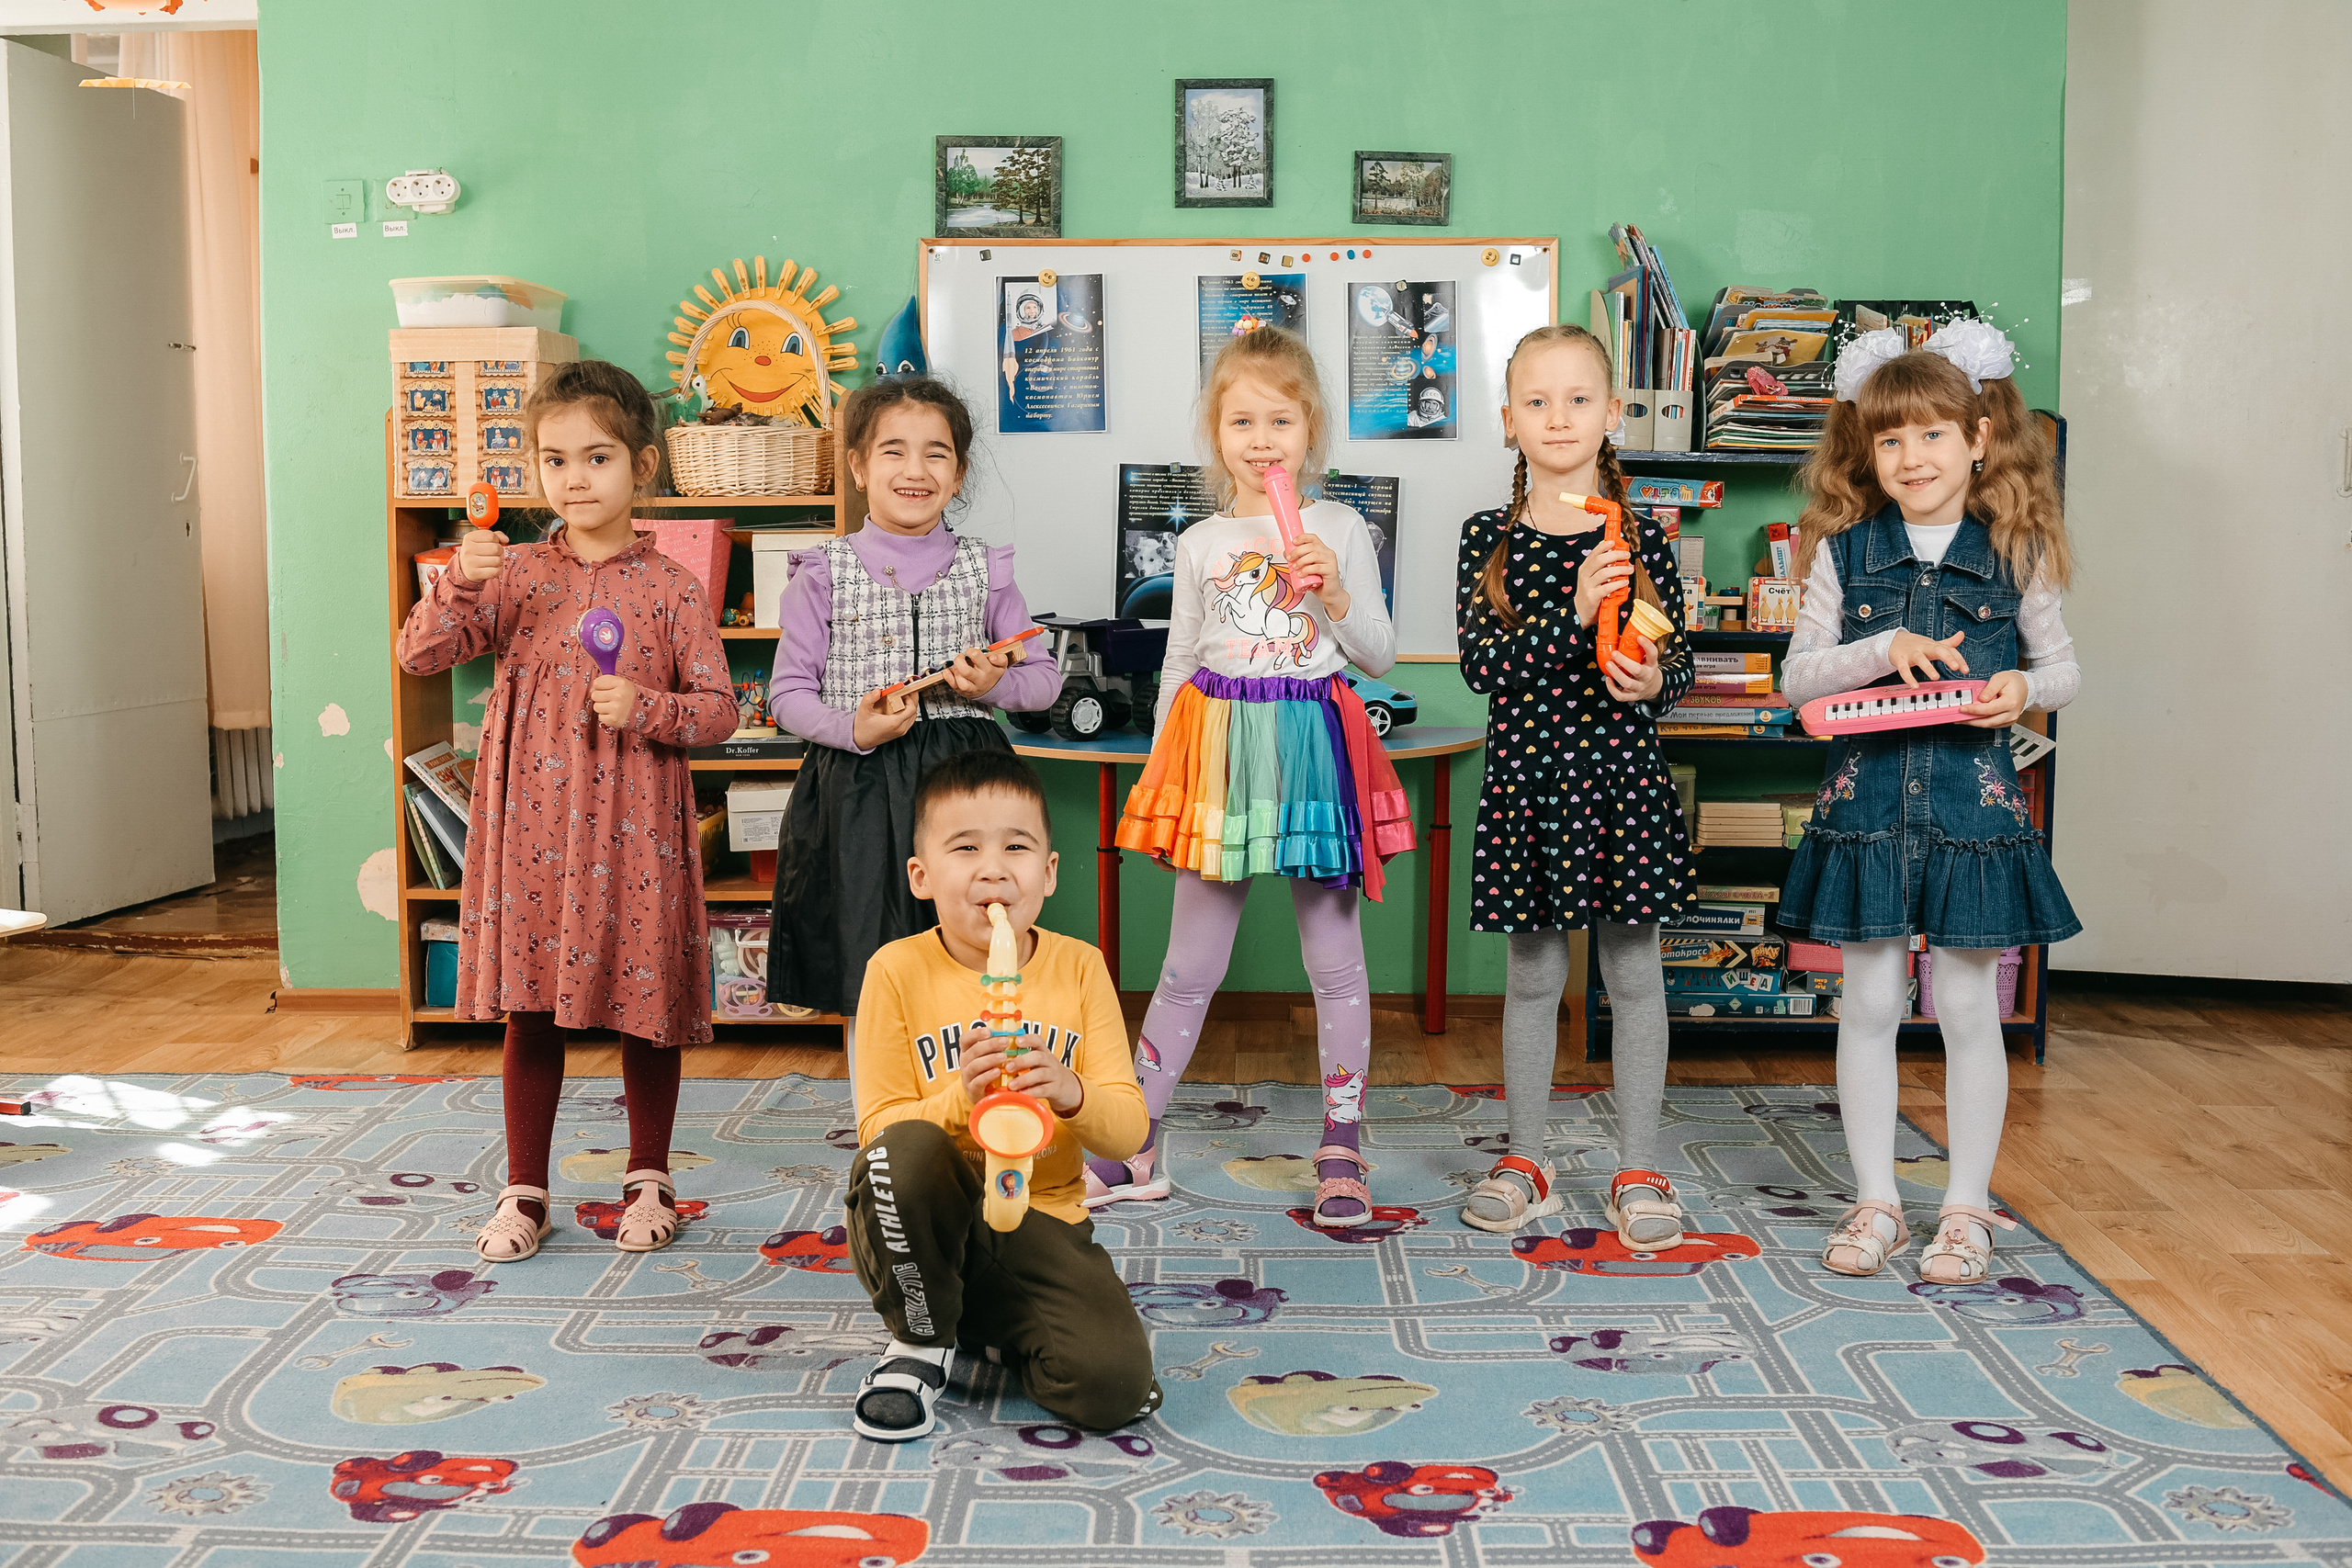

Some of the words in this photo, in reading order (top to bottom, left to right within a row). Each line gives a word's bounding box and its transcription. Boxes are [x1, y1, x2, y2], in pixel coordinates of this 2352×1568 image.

[1226, 637, 1293, 659] TEAM
[1690, 695, 1722, 704] ЗВУКОВ
[1661, 947, 1708, 959] отокросс
[866, 1145, 910, 1253] ATHLETIC
